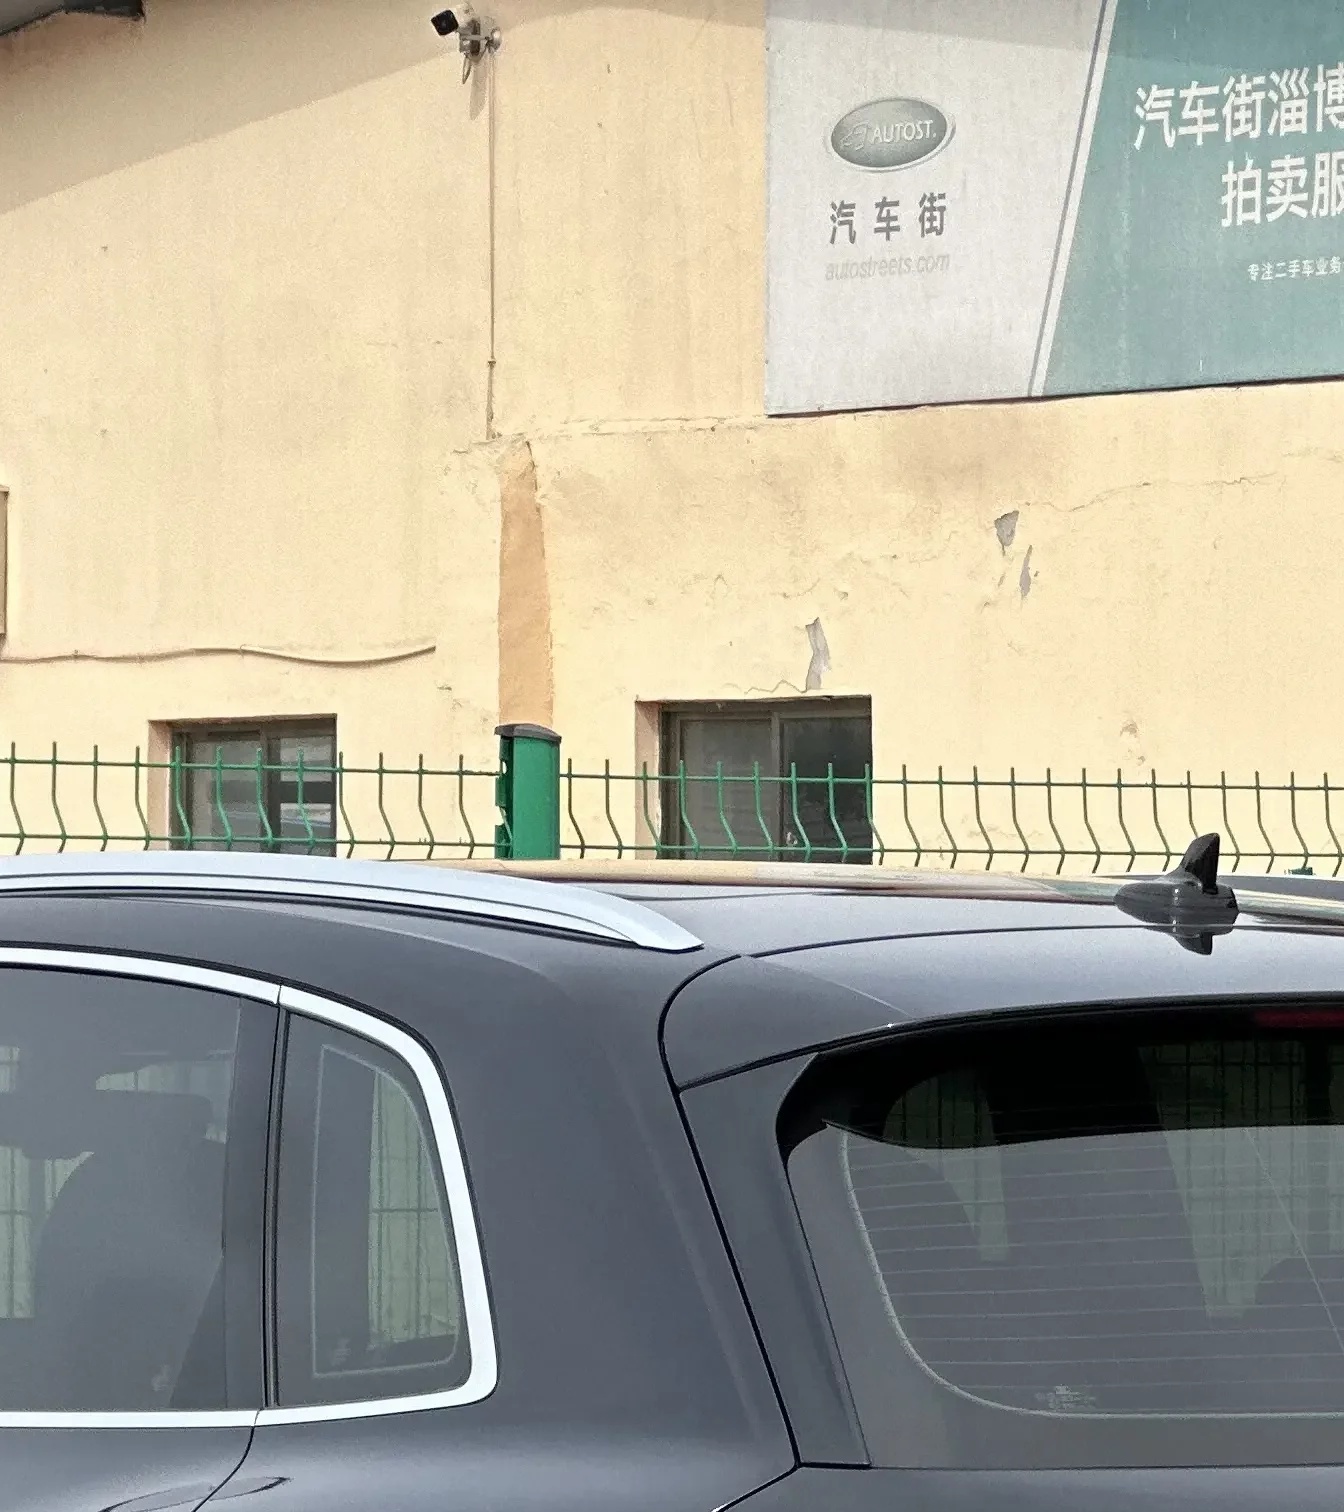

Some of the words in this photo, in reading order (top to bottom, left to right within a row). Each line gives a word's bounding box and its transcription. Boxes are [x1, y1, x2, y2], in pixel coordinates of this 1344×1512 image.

[829, 191, 947, 245] 汽车街
[824, 254, 950, 281] autostreets.com
